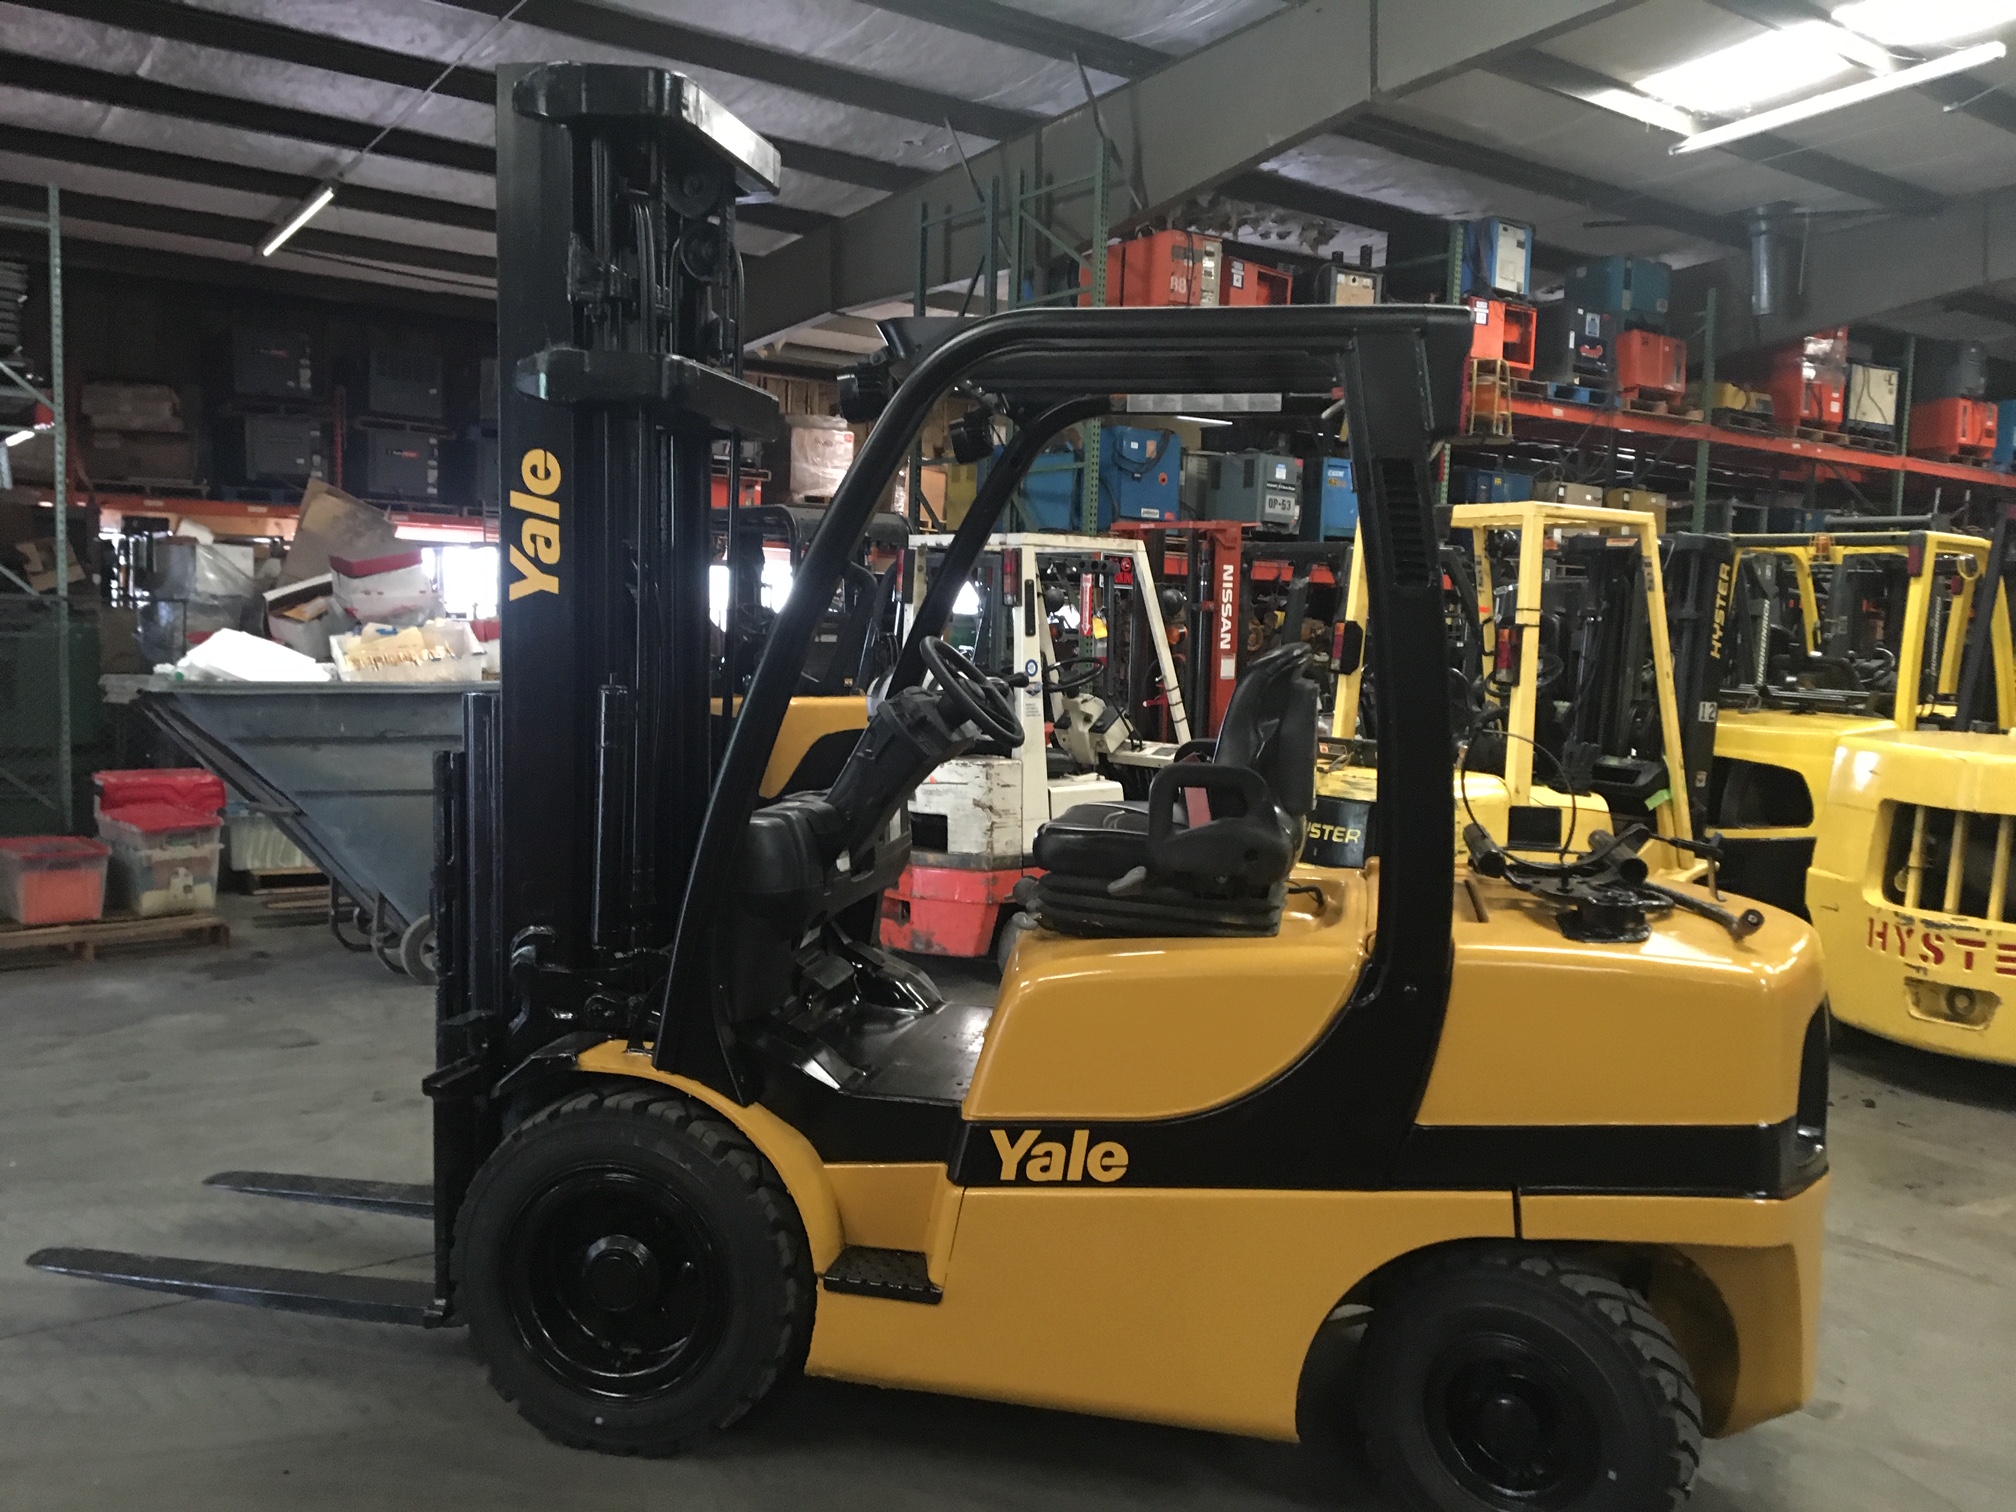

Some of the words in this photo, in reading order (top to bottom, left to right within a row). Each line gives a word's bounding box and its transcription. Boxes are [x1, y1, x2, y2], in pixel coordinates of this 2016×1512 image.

[509, 448, 562, 602] Yale
[1220, 564, 1234, 649] NISSAN
[1710, 563, 1731, 659] HYSTER
[1701, 703, 1716, 721] 12
[1307, 821, 1361, 843] STER
[990, 1129, 1129, 1182] Yale
